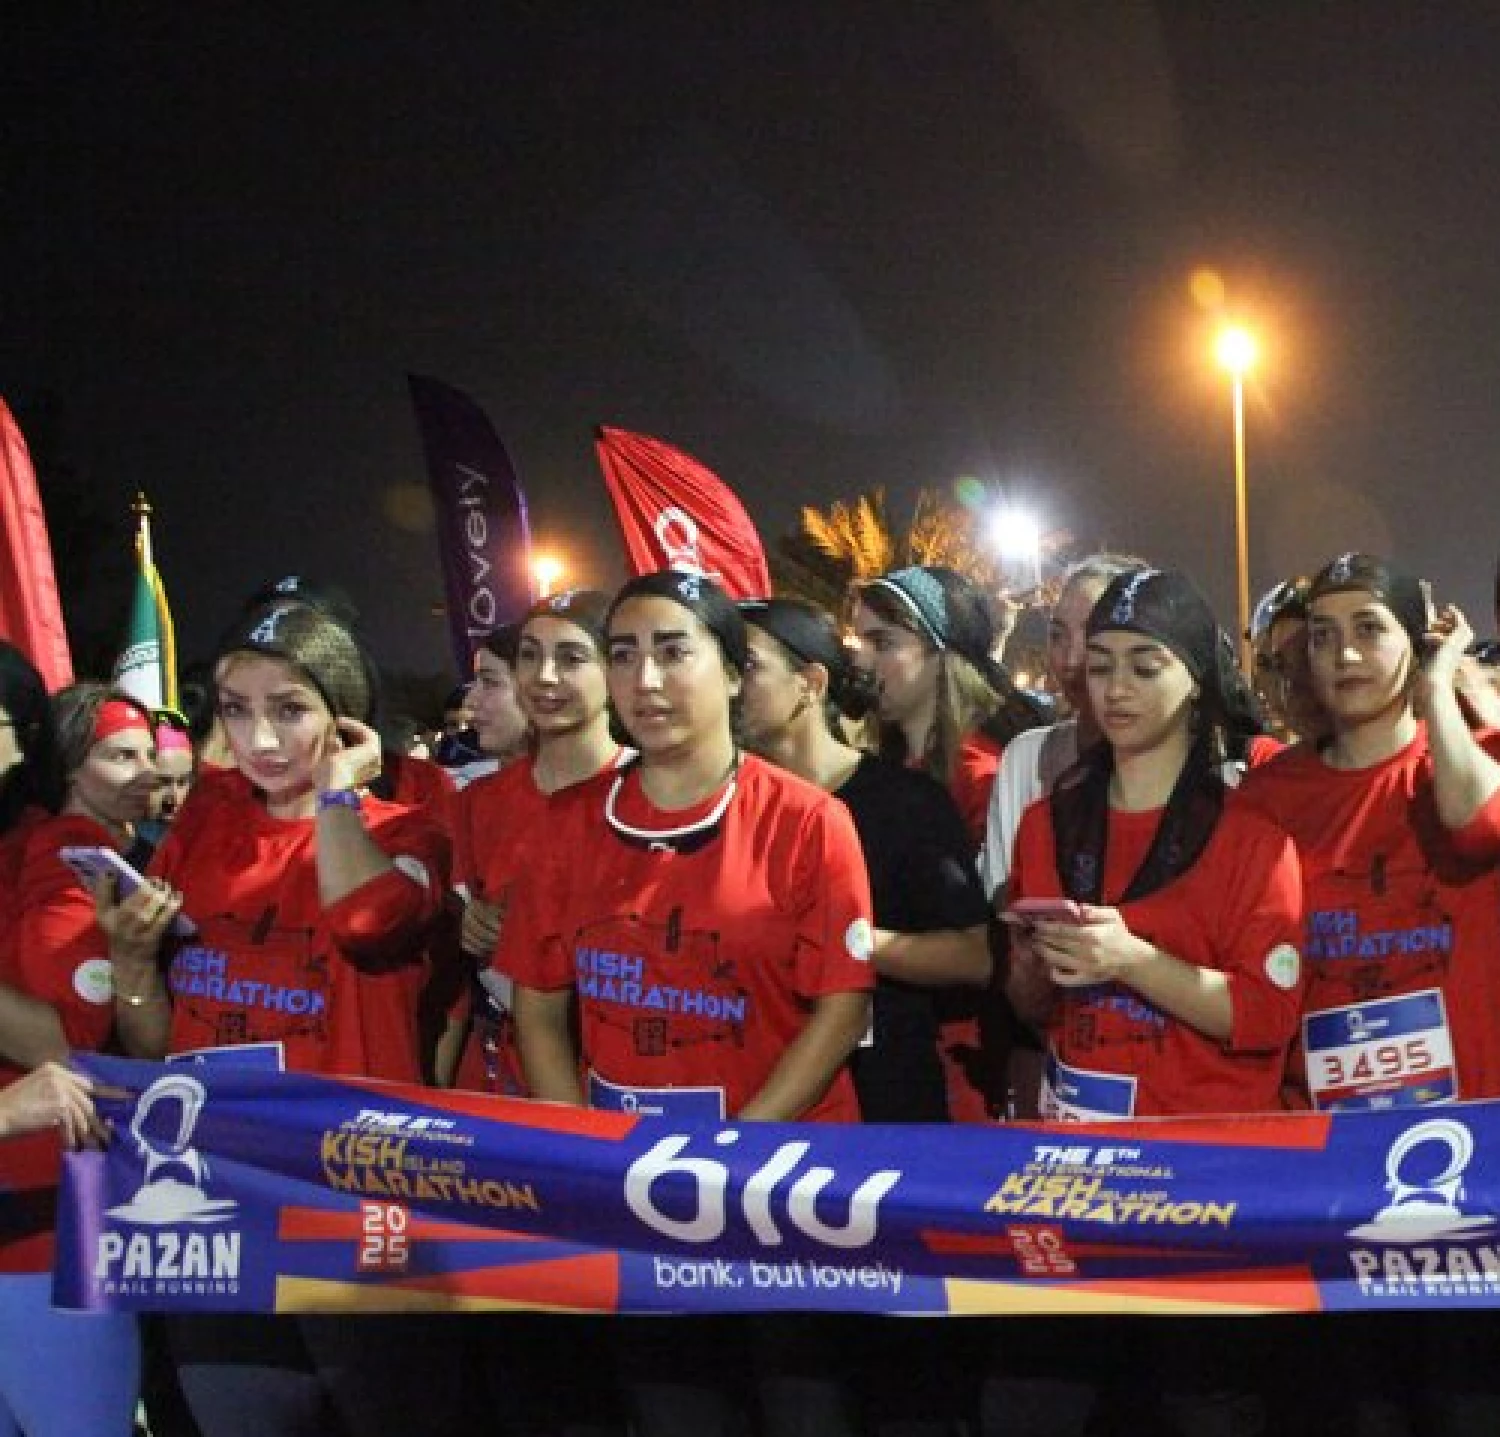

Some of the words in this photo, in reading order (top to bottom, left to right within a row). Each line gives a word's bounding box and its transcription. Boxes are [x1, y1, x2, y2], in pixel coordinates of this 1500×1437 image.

[455, 463, 497, 636] lovely
[1322, 1038, 1433, 1086] 3495
[321, 1130, 407, 1170] KISH
[1034, 1146, 1092, 1165] THE
[323, 1164, 540, 1210] MARATHON
[624, 1129, 901, 1248] blu
[997, 1173, 1104, 1200] KISH
[363, 1205, 407, 1233] 20
[984, 1195, 1238, 1225] MARATHON
[96, 1231, 241, 1278] PAZAN
[361, 1235, 409, 1265] 25
[750, 1259, 805, 1288] but
[809, 1260, 902, 1296] lovely
